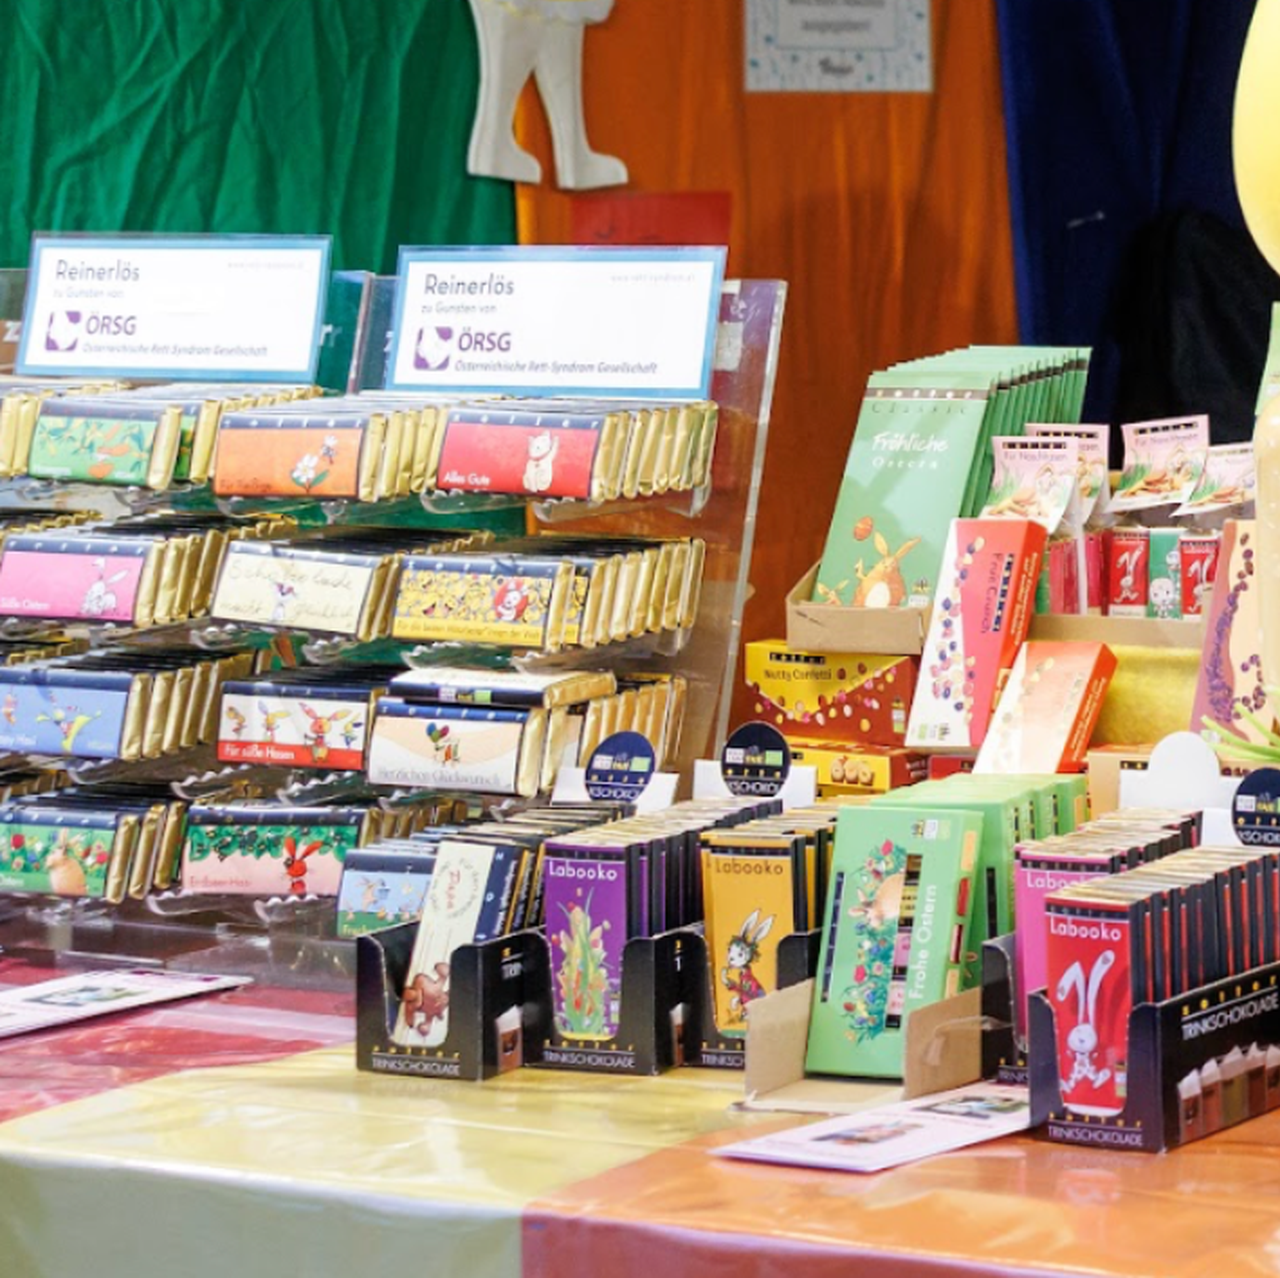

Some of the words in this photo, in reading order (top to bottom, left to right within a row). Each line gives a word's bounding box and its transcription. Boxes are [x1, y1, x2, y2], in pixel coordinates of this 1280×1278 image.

[55, 259, 140, 283] Reinerlös
[424, 272, 515, 296] Reinerlös
[86, 310, 137, 337] ÖRSG
[458, 328, 512, 353] ÖRSG
[442, 472, 467, 485] Alles
[468, 473, 491, 487] Gute
[764, 669, 792, 682] Nutty
[793, 668, 832, 681] Confetti
[224, 743, 241, 757] Für
[242, 745, 262, 759] süße
[264, 746, 296, 761] Hasen
[548, 859, 618, 882] Labooko
[715, 858, 784, 876] Labooko
[916, 884, 937, 944] Ostern
[1050, 917, 1122, 941] Labooko
[908, 948, 931, 1000] Frohe
[1181, 992, 1280, 1042] TRINKSCHOKOLADE
[543, 1050, 637, 1069] TRINKSCHOKOLADE
[1048, 1125, 1144, 1148] TRINKSCHOKOLADE
